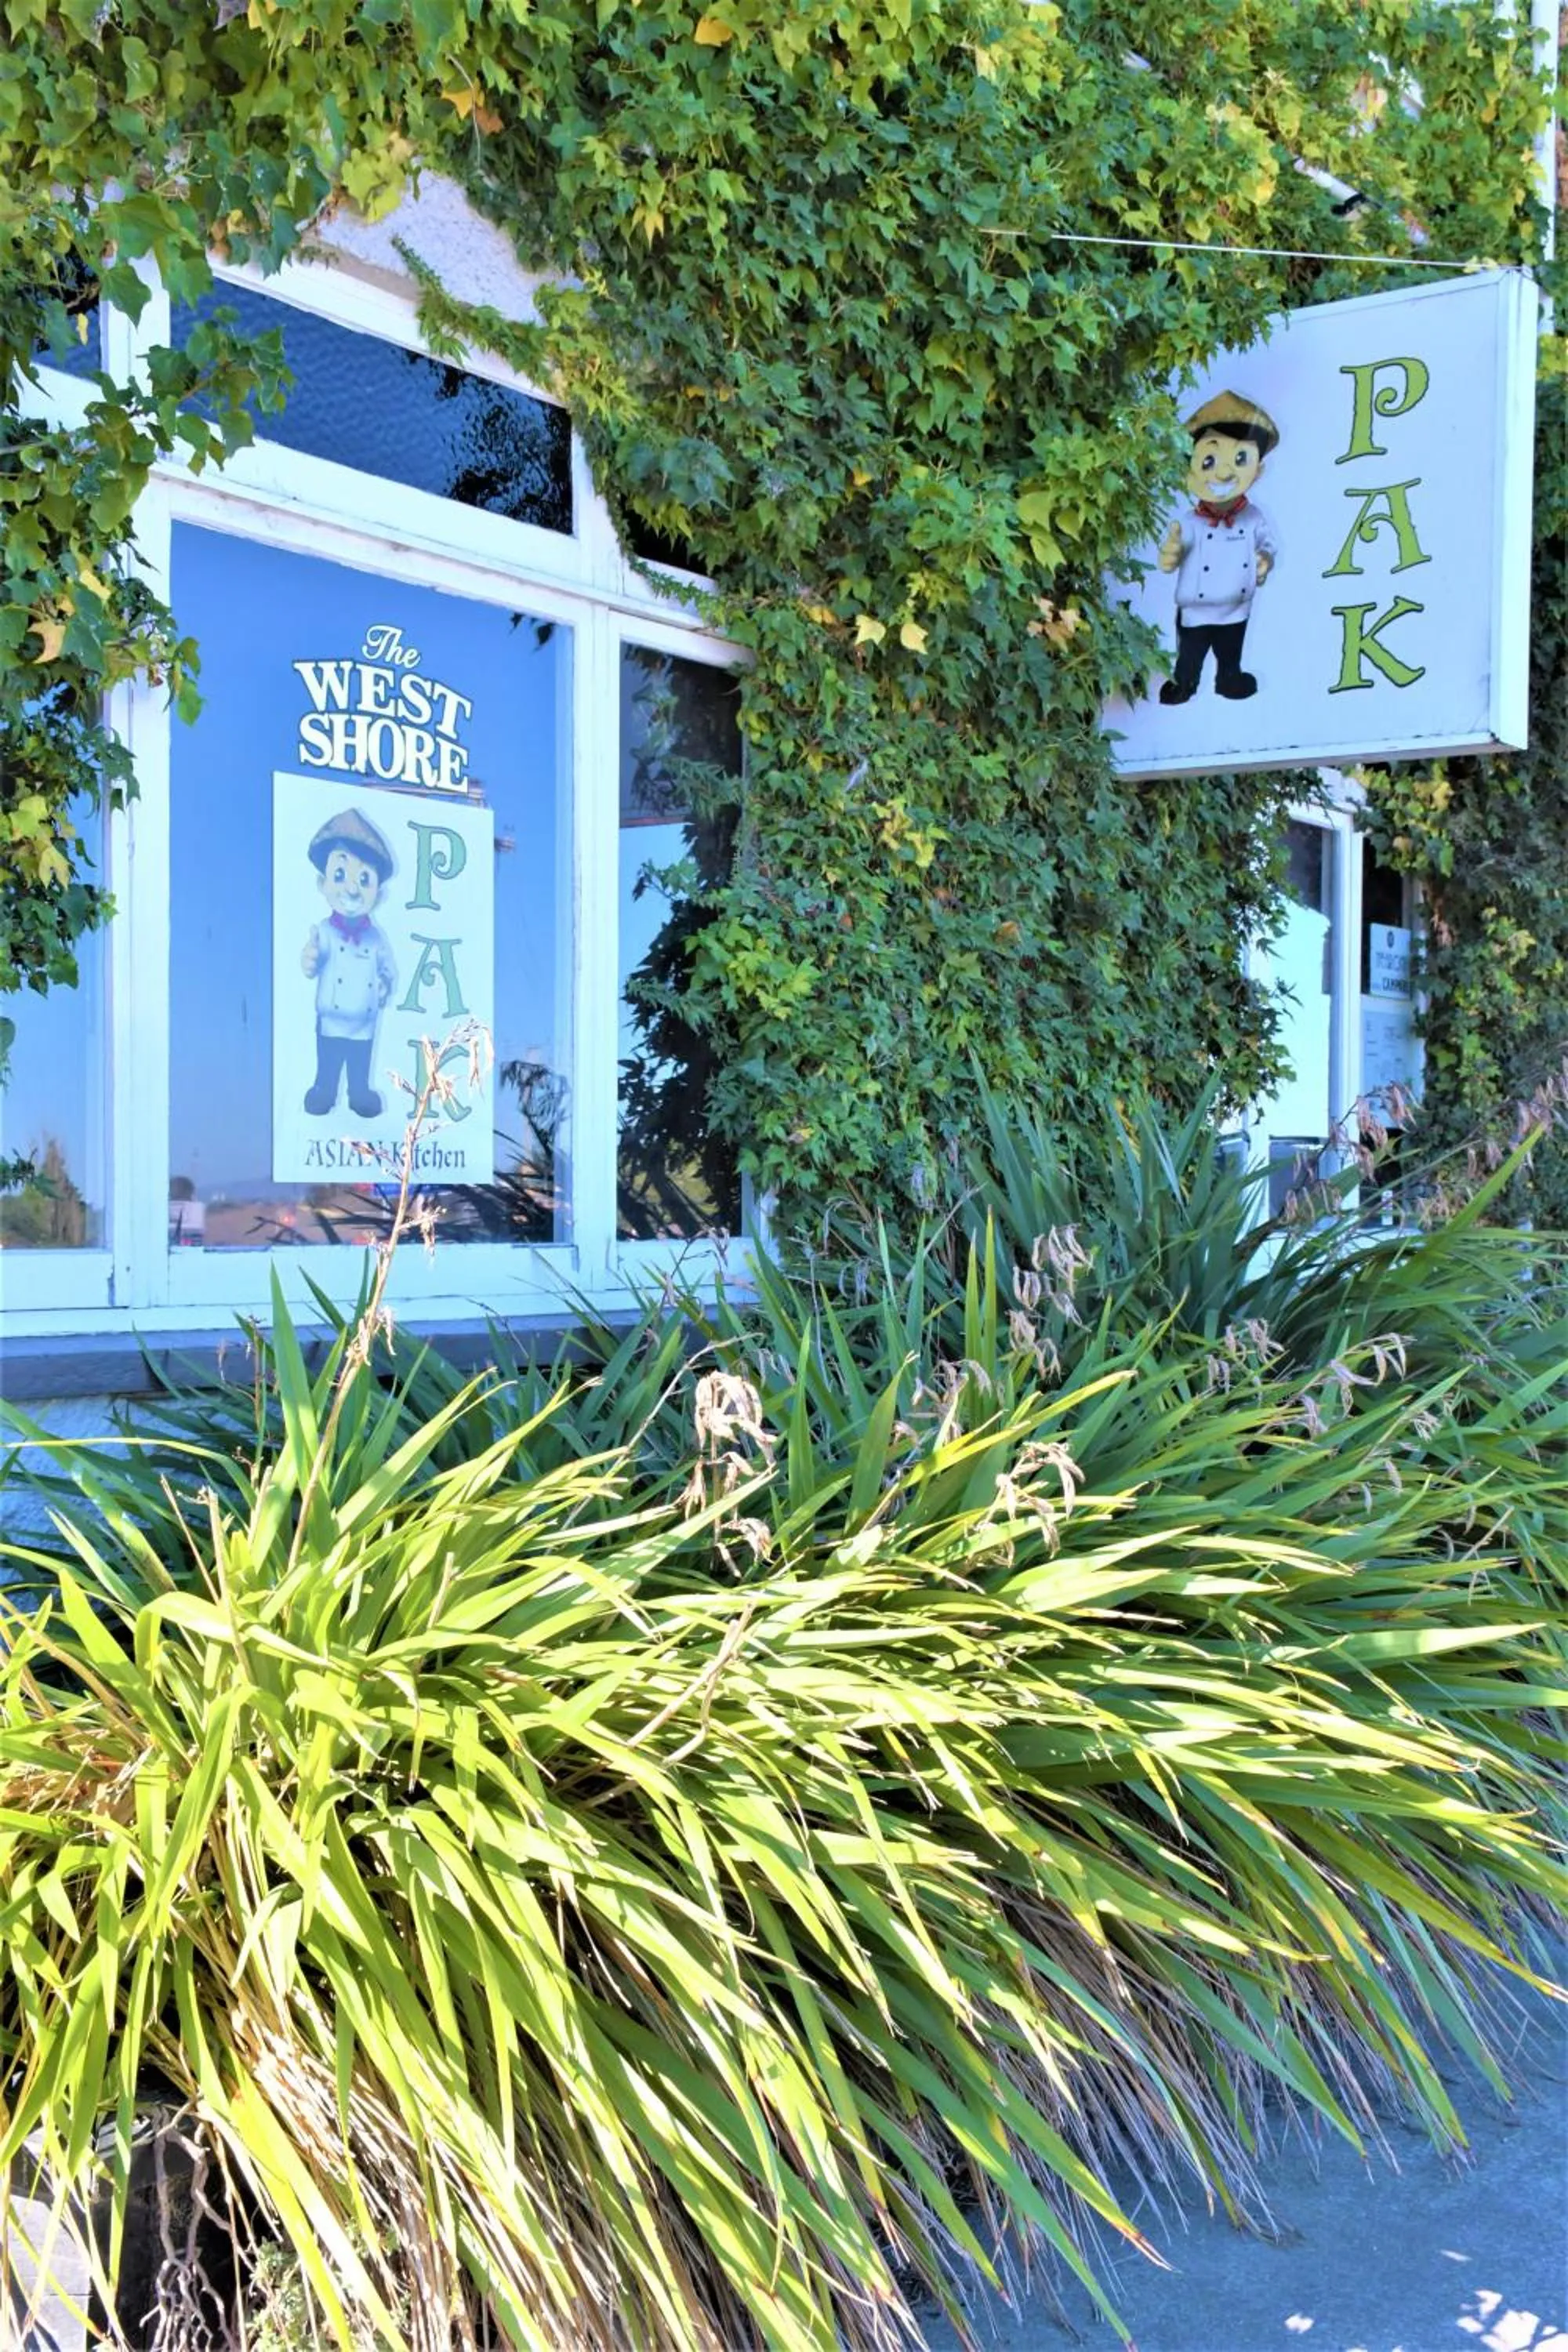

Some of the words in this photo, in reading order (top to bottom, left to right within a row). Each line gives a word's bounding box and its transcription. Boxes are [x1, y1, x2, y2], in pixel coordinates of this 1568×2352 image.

[1323, 357, 1432, 695] PAK
[361, 624, 420, 669] The
[292, 660, 472, 740] WEST
[298, 711, 470, 793] SHORE
[397, 820, 473, 1123] PAK
[391, 1140, 466, 1171] Ktchen
